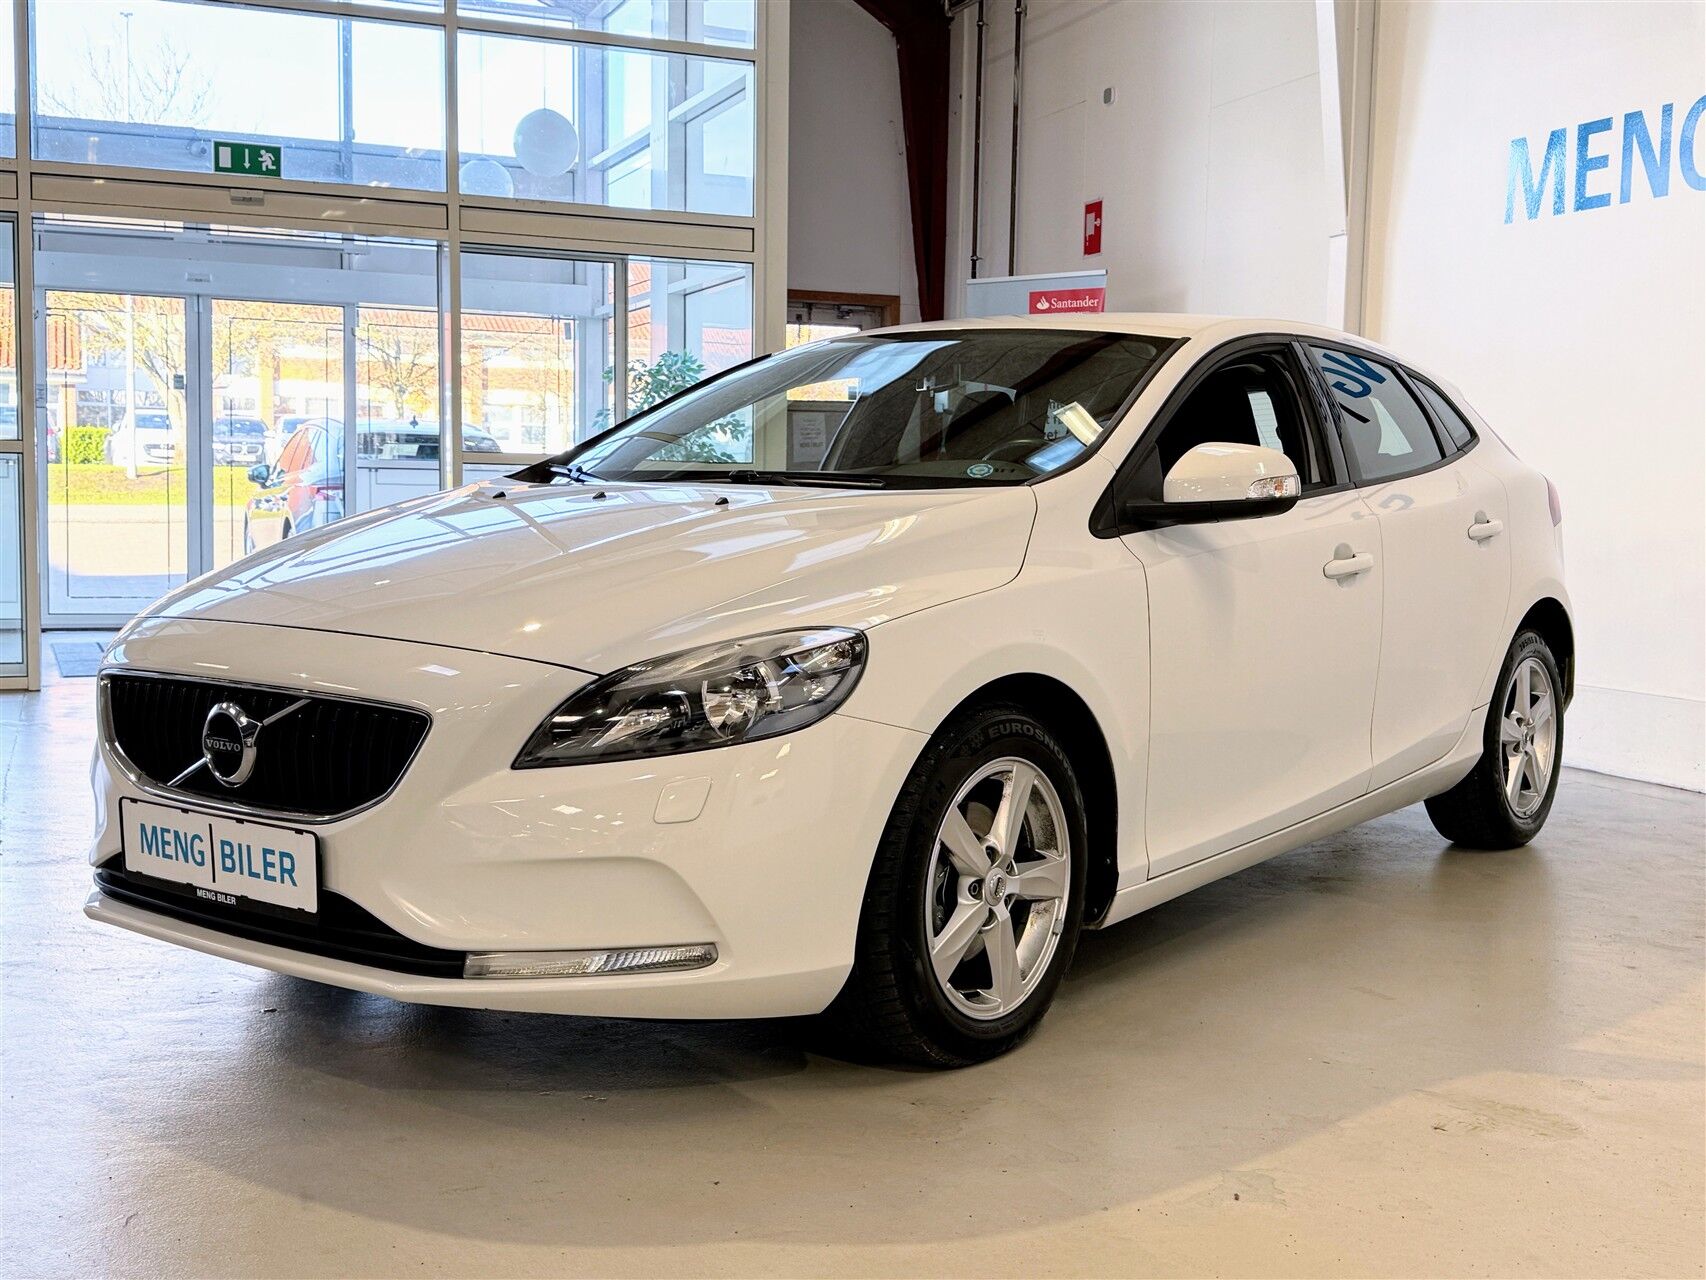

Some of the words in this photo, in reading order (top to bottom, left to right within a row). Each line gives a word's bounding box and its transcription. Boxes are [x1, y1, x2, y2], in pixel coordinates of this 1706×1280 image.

[1051, 296, 1099, 309] Santander
[205, 739, 241, 752] VOLVO
[140, 823, 205, 866] MENG
[219, 839, 298, 887] BILER
[196, 888, 215, 901] MENG
[217, 894, 237, 905] BILER
